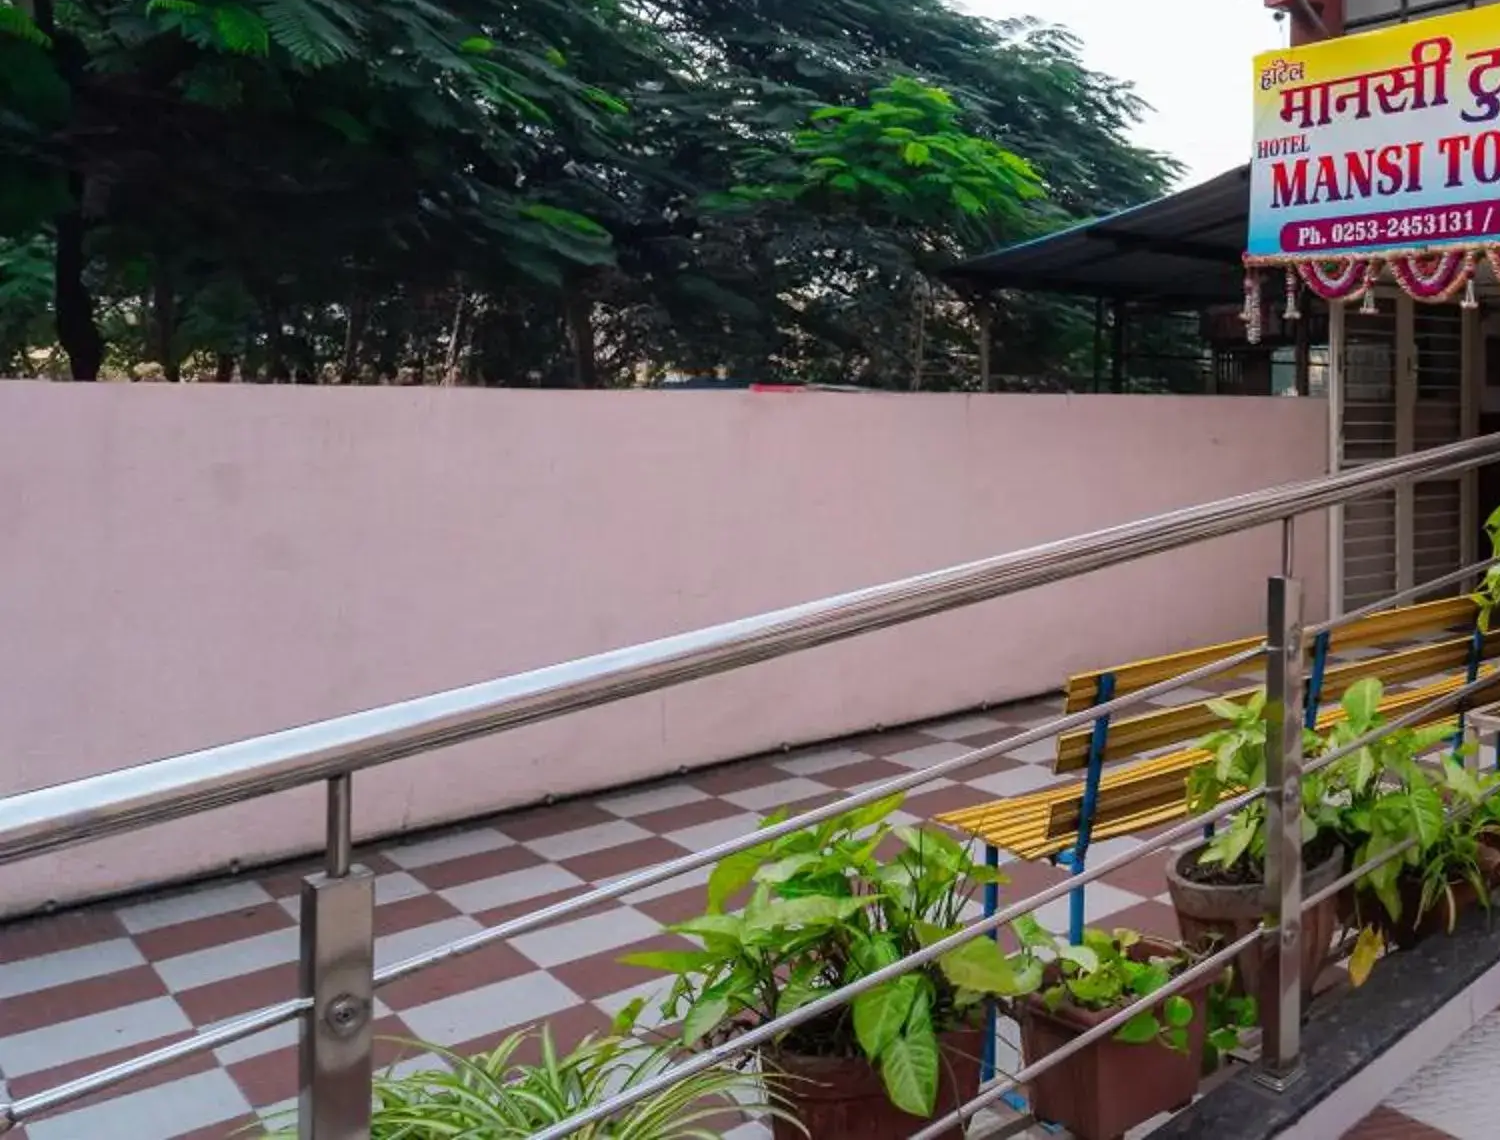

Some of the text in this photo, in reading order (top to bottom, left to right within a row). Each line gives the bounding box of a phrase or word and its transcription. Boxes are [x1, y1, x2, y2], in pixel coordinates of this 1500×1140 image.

[1279, 36, 1452, 128] मानसी
[1257, 134, 1310, 159] HOTEL
[1269, 142, 1422, 209] MANSI
[1298, 225, 1327, 247] Ph.
[1331, 210, 1473, 242] 0253-2453131
